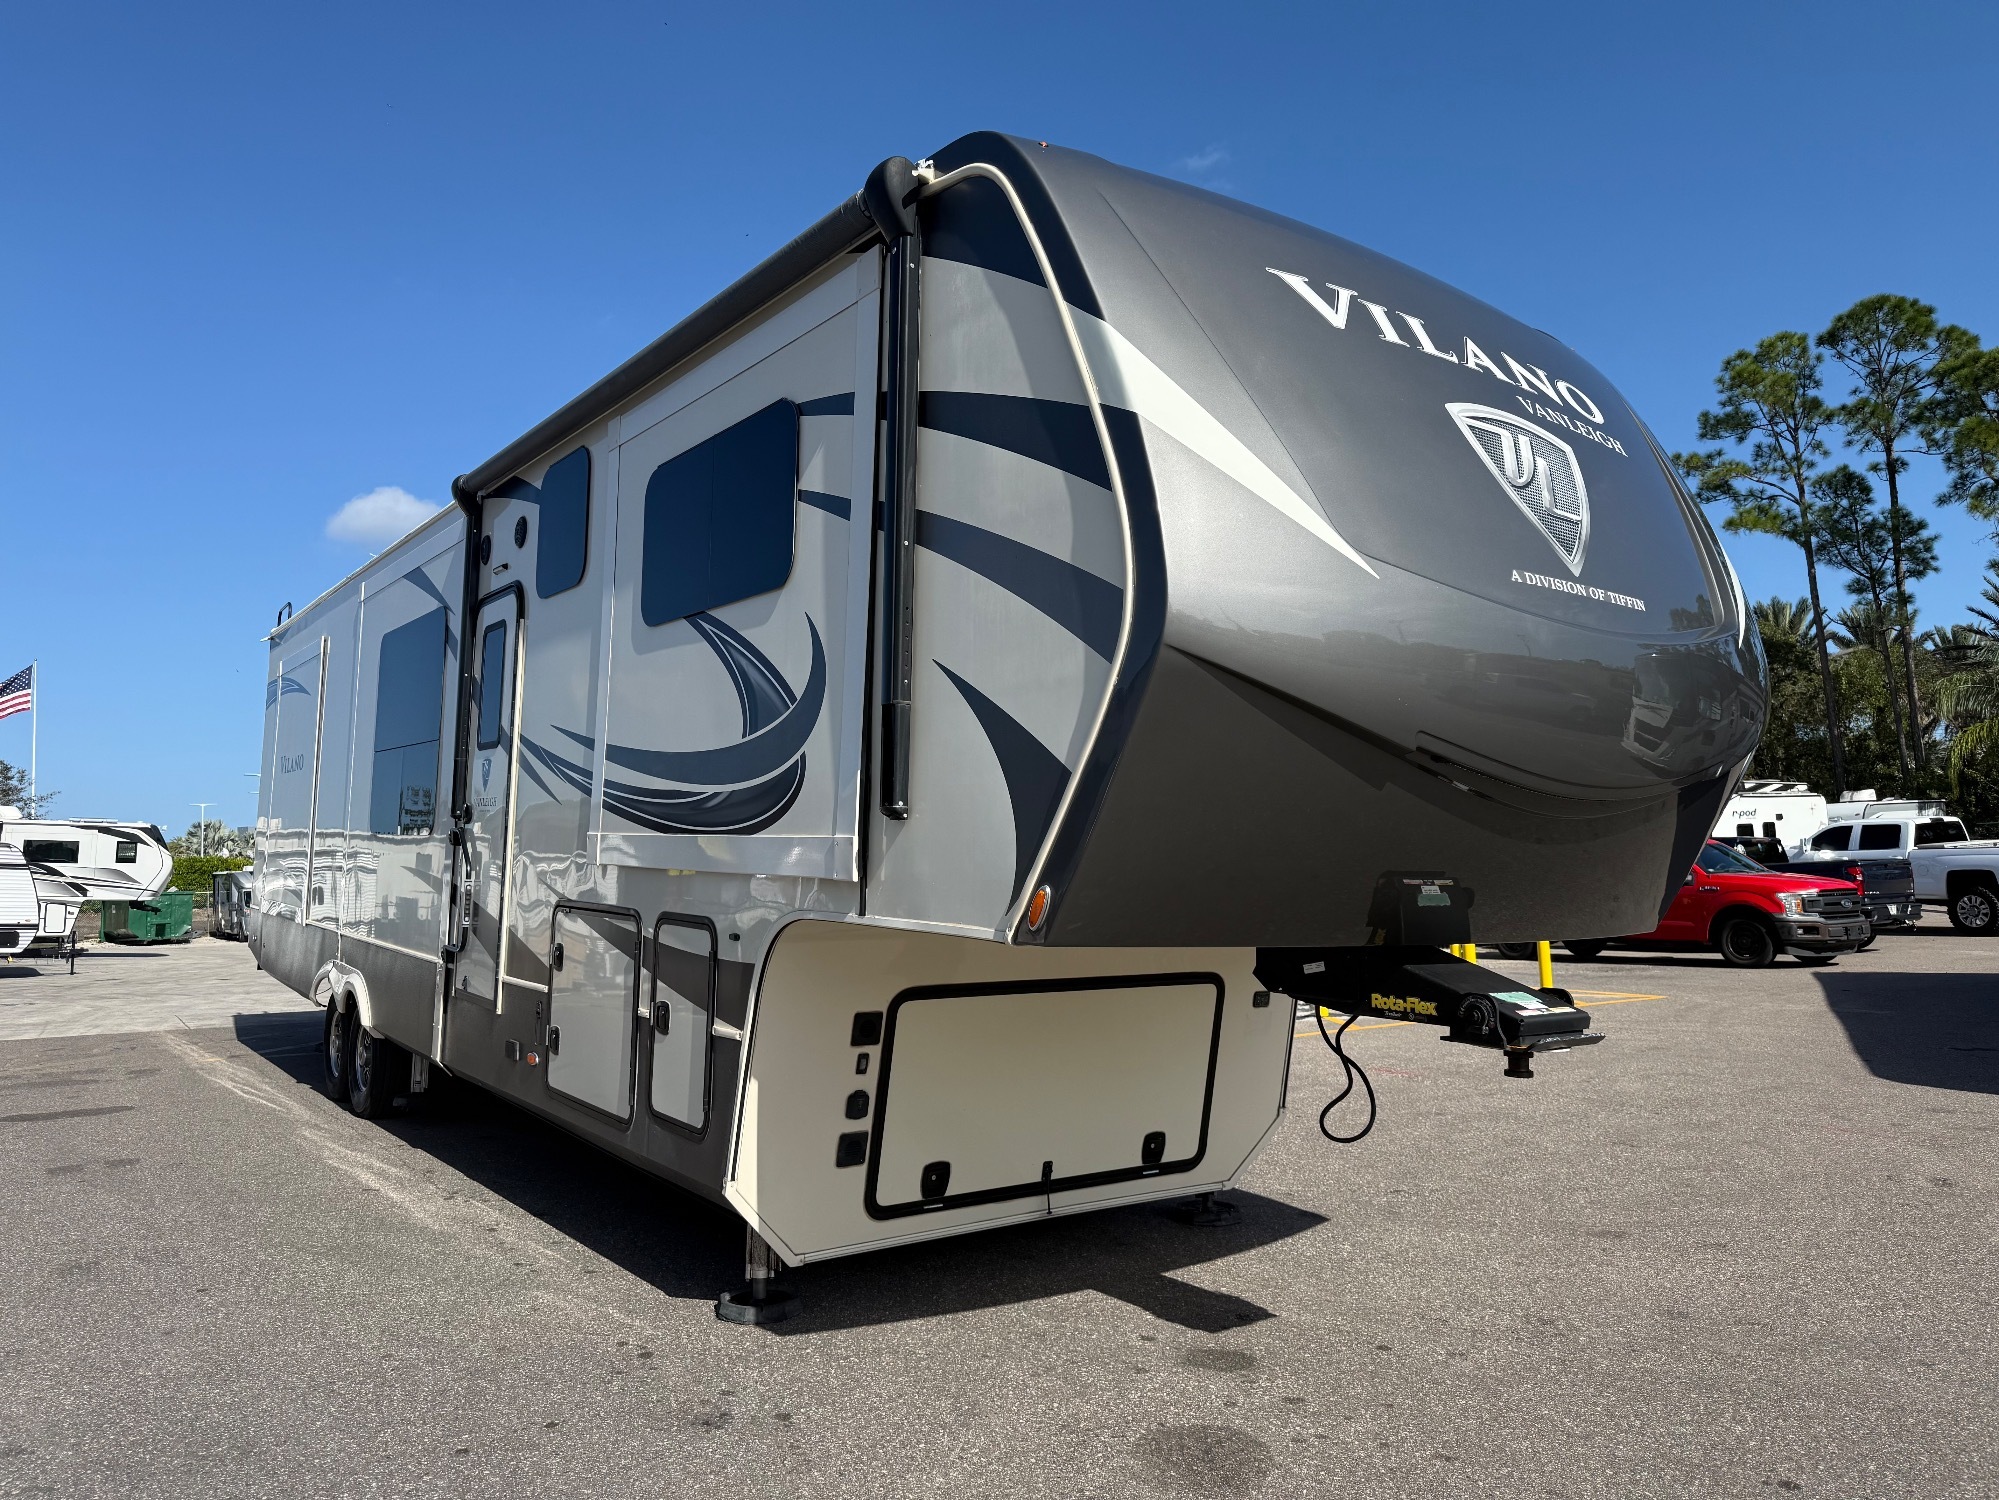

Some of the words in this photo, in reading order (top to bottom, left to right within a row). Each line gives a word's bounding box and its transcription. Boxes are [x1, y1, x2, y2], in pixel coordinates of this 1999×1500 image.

[1265, 266, 1604, 424] VILANO
[1515, 395, 1628, 457] VANLEIGH
[1511, 569, 1522, 583] A
[1523, 571, 1587, 597] DIVISION
[1588, 586, 1605, 601] OF
[1607, 591, 1646, 611] TIFFIN
[280, 753, 304, 774] VILANO
